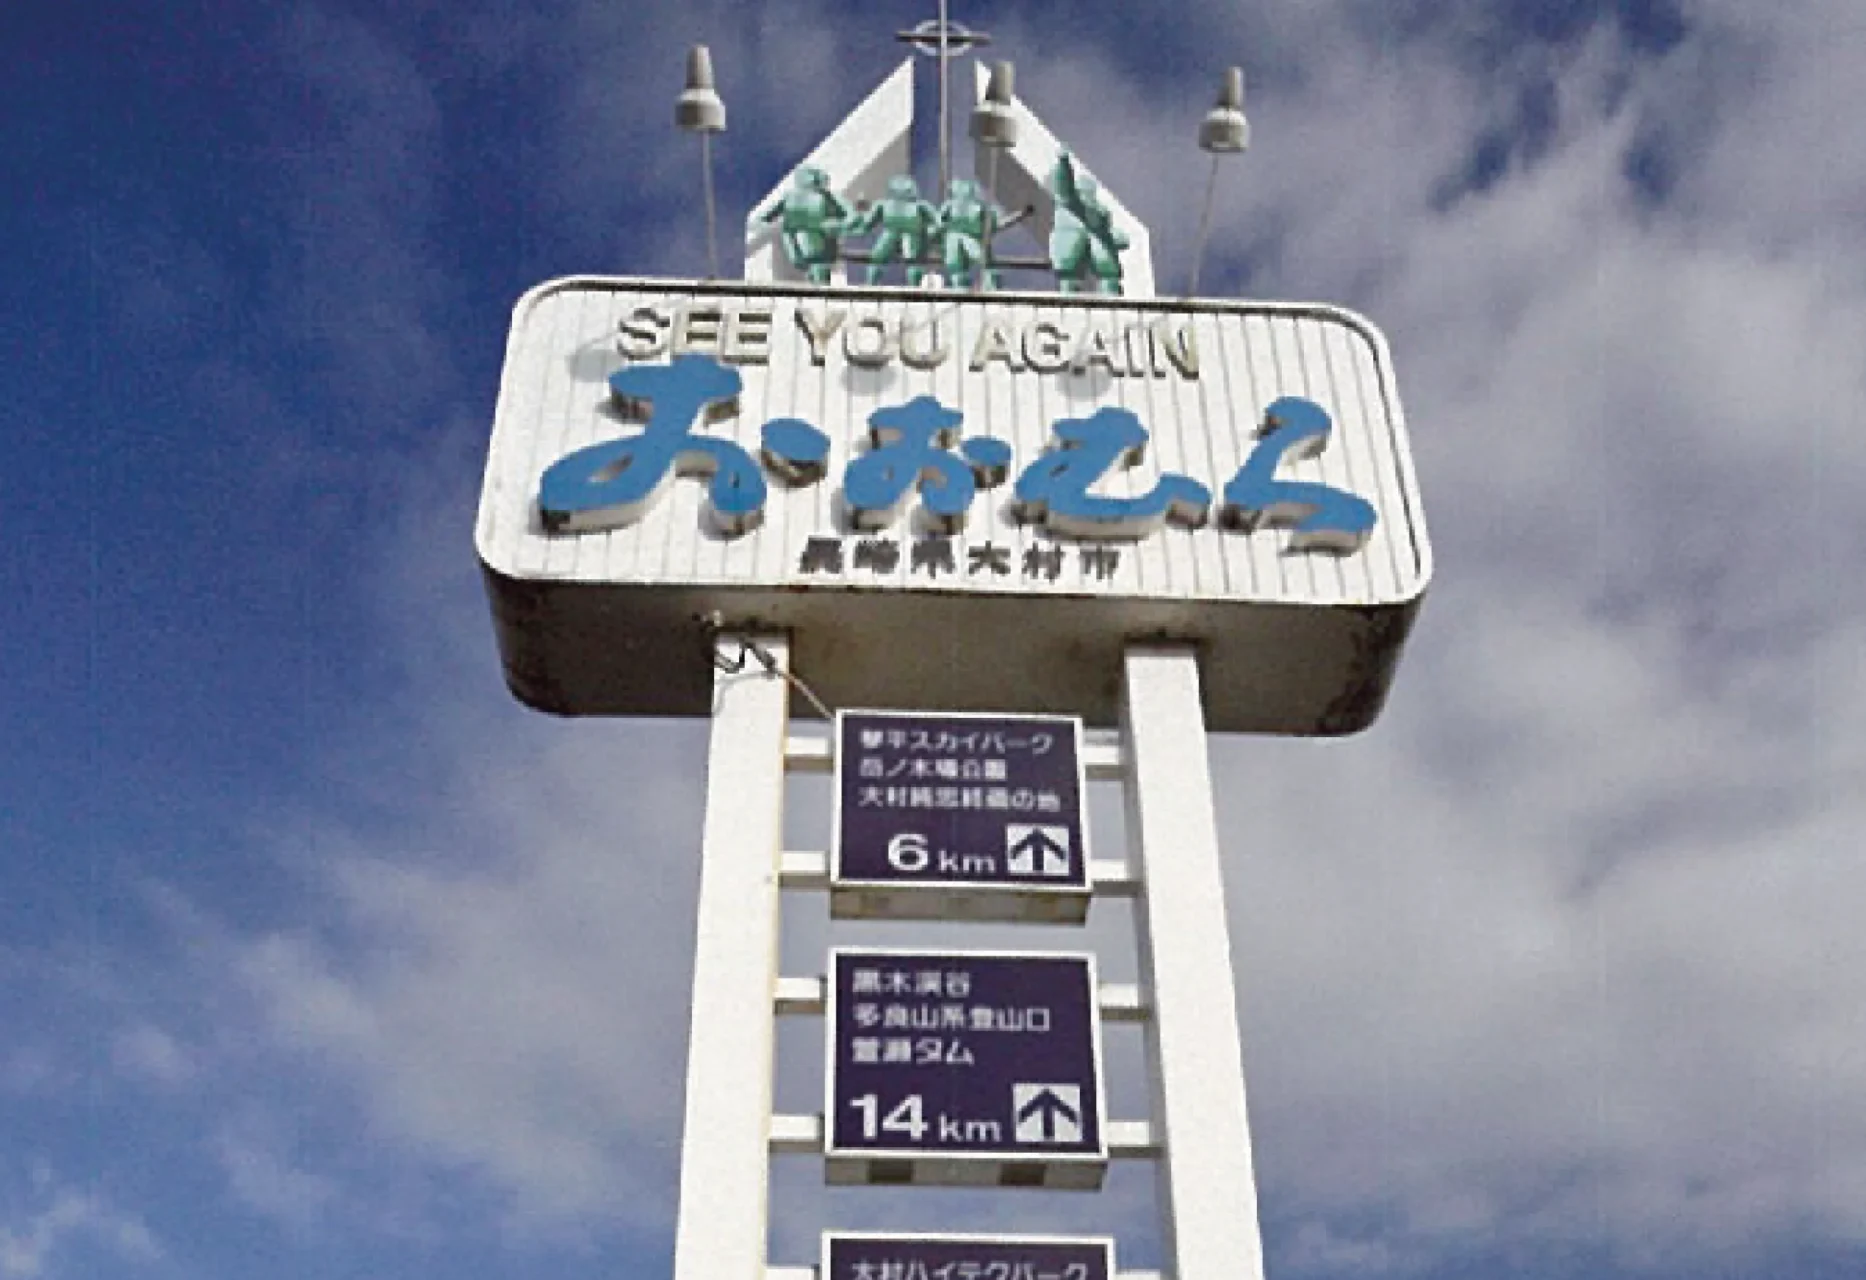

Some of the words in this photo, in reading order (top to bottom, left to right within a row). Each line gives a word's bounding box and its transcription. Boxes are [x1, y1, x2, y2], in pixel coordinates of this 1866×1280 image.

[617, 307, 773, 366] SEE
[794, 308, 949, 370] YOU
[968, 316, 1200, 381] AGAIN
[538, 352, 1379, 550] おおむら
